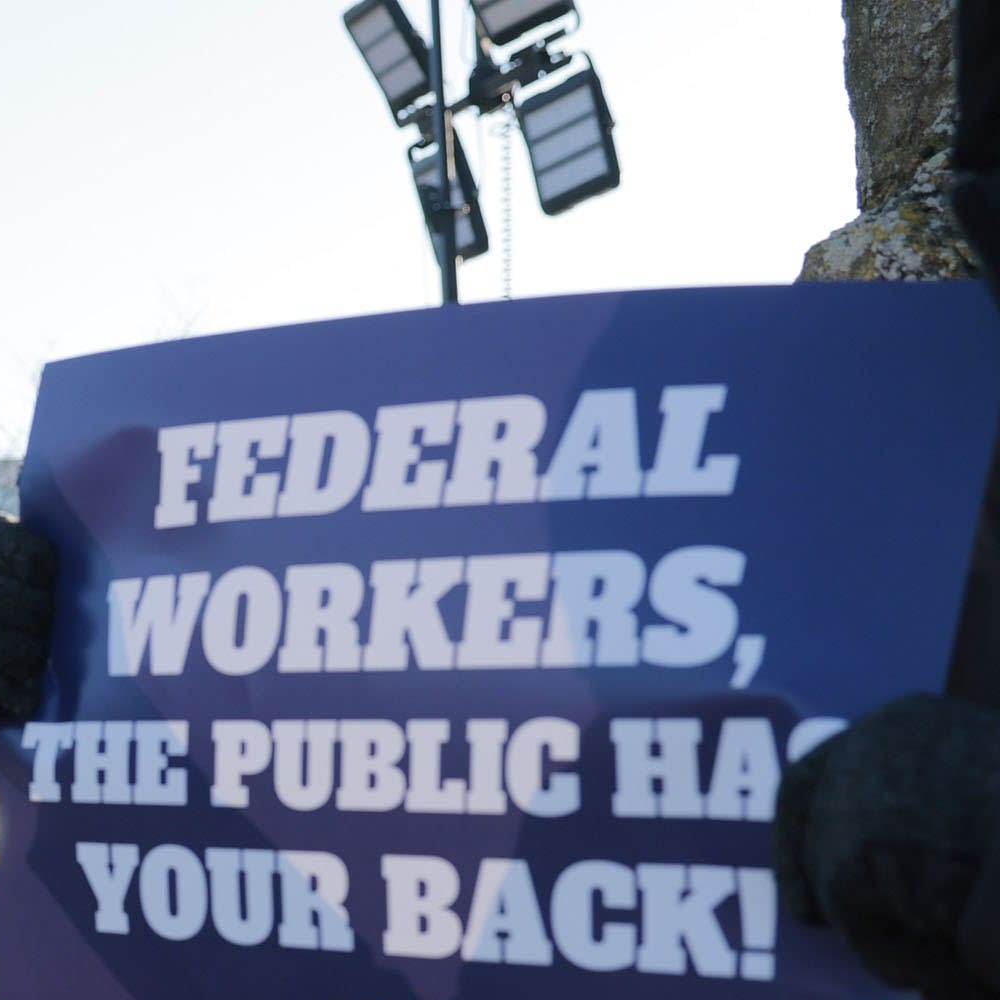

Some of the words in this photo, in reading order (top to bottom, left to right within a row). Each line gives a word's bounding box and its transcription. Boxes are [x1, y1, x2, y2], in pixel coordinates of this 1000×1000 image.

[153, 385, 739, 530] FEDERAL
[106, 546, 767, 688] WORKERS,
[22, 719, 190, 806] THE
[210, 717, 581, 817] PUBLIC
[611, 717, 849, 823] HA
[76, 842, 354, 952] YOUR
[381, 853, 777, 981] BACK!
